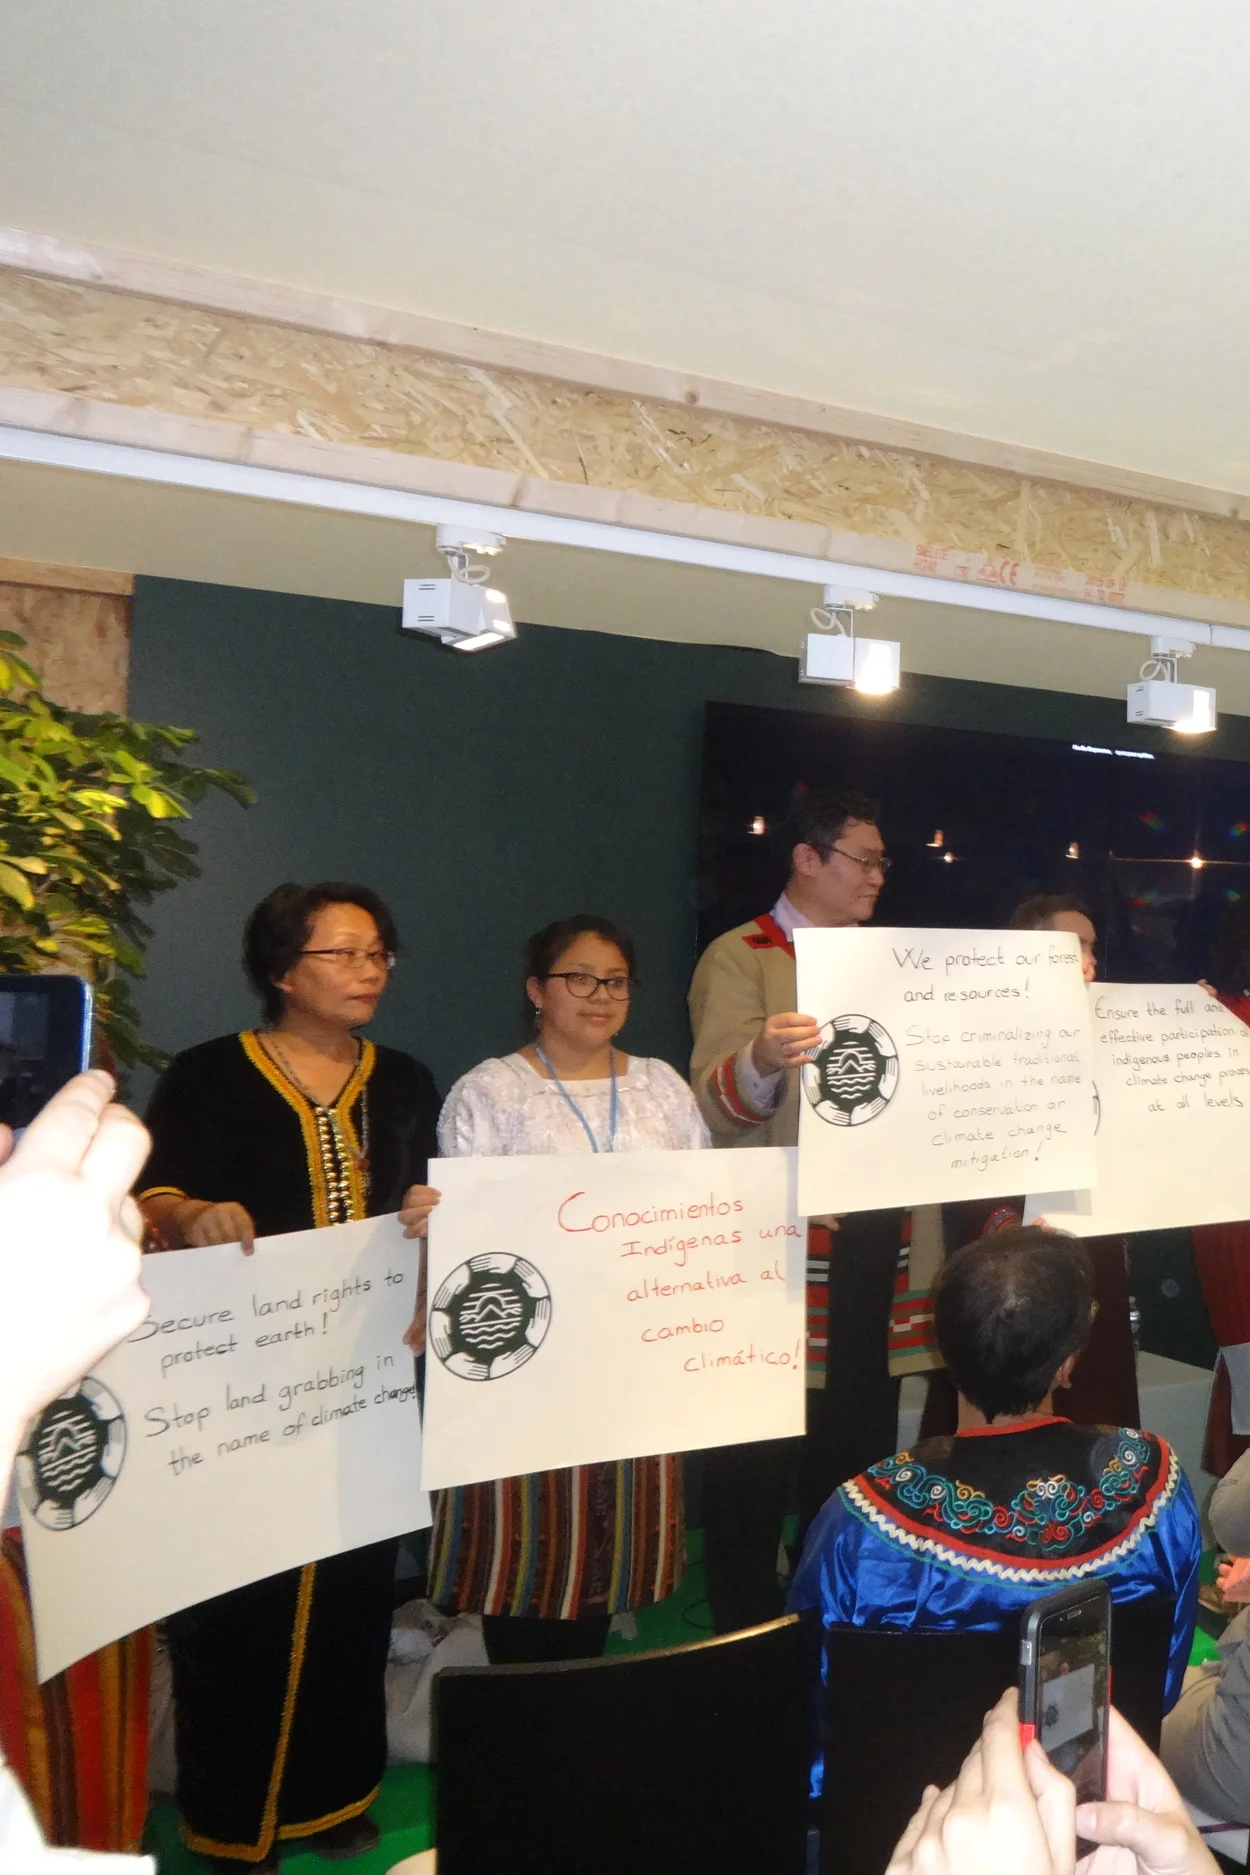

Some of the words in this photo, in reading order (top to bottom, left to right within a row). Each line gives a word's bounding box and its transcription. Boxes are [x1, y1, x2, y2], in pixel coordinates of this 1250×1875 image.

[892, 947, 933, 971] We
[945, 946, 1004, 976] protect
[1016, 952, 1042, 966] our
[904, 984, 935, 1003] and
[944, 977, 1030, 1003] resources!
[1094, 996, 1139, 1019] Ensure
[1147, 1001, 1167, 1016] the
[1175, 998, 1194, 1015] full
[905, 1023, 950, 1048] Stop
[960, 1026, 1051, 1049] criminalizing
[1059, 1027, 1081, 1040] our
[1100, 1029, 1154, 1045] effective
[1160, 1024, 1236, 1046] participation
[914, 1053, 1003, 1073] sustainable
[1012, 1047, 1081, 1066] traditional
[1111, 1052, 1170, 1071] indigenous
[1176, 1048, 1221, 1068] peoples
[1228, 1047, 1240, 1057] in
[921, 1077, 992, 1098] livelihoods
[1000, 1076, 1014, 1088] in
[1020, 1072, 1044, 1087] the
[1051, 1073, 1082, 1086] name
[1126, 1071, 1168, 1086] climate
[1173, 1069, 1212, 1087] change
[928, 1105, 944, 1122] of
[953, 1102, 1039, 1119] conservation
[1047, 1099, 1067, 1110] or
[1148, 1099, 1166, 1112] at
[1176, 1094, 1190, 1109] all
[931, 1129, 995, 1147] climate
[1008, 1122, 1069, 1140] change
[951, 1140, 1044, 1172] mitigation!
[557, 1191, 744, 1233] Conocimientos
[620, 1228, 743, 1267] Indígenas
[759, 1223, 802, 1240] una
[252, 1290, 304, 1318] land
[311, 1278, 372, 1313] rights
[384, 1268, 404, 1287] to
[626, 1269, 747, 1302] alternativa
[760, 1260, 785, 1282] al
[640, 1317, 725, 1343] cambio
[161, 1336, 238, 1379] protect
[255, 1311, 330, 1349] earth!
[683, 1338, 801, 1373] climático!
[144, 1402, 210, 1439] Stop
[225, 1382, 266, 1411] land
[277, 1365, 365, 1415] grabbing
[375, 1354, 395, 1372] in
[168, 1448, 204, 1477] the
[217, 1428, 271, 1457] name
[282, 1410, 306, 1438] of
[310, 1398, 368, 1428] climate
